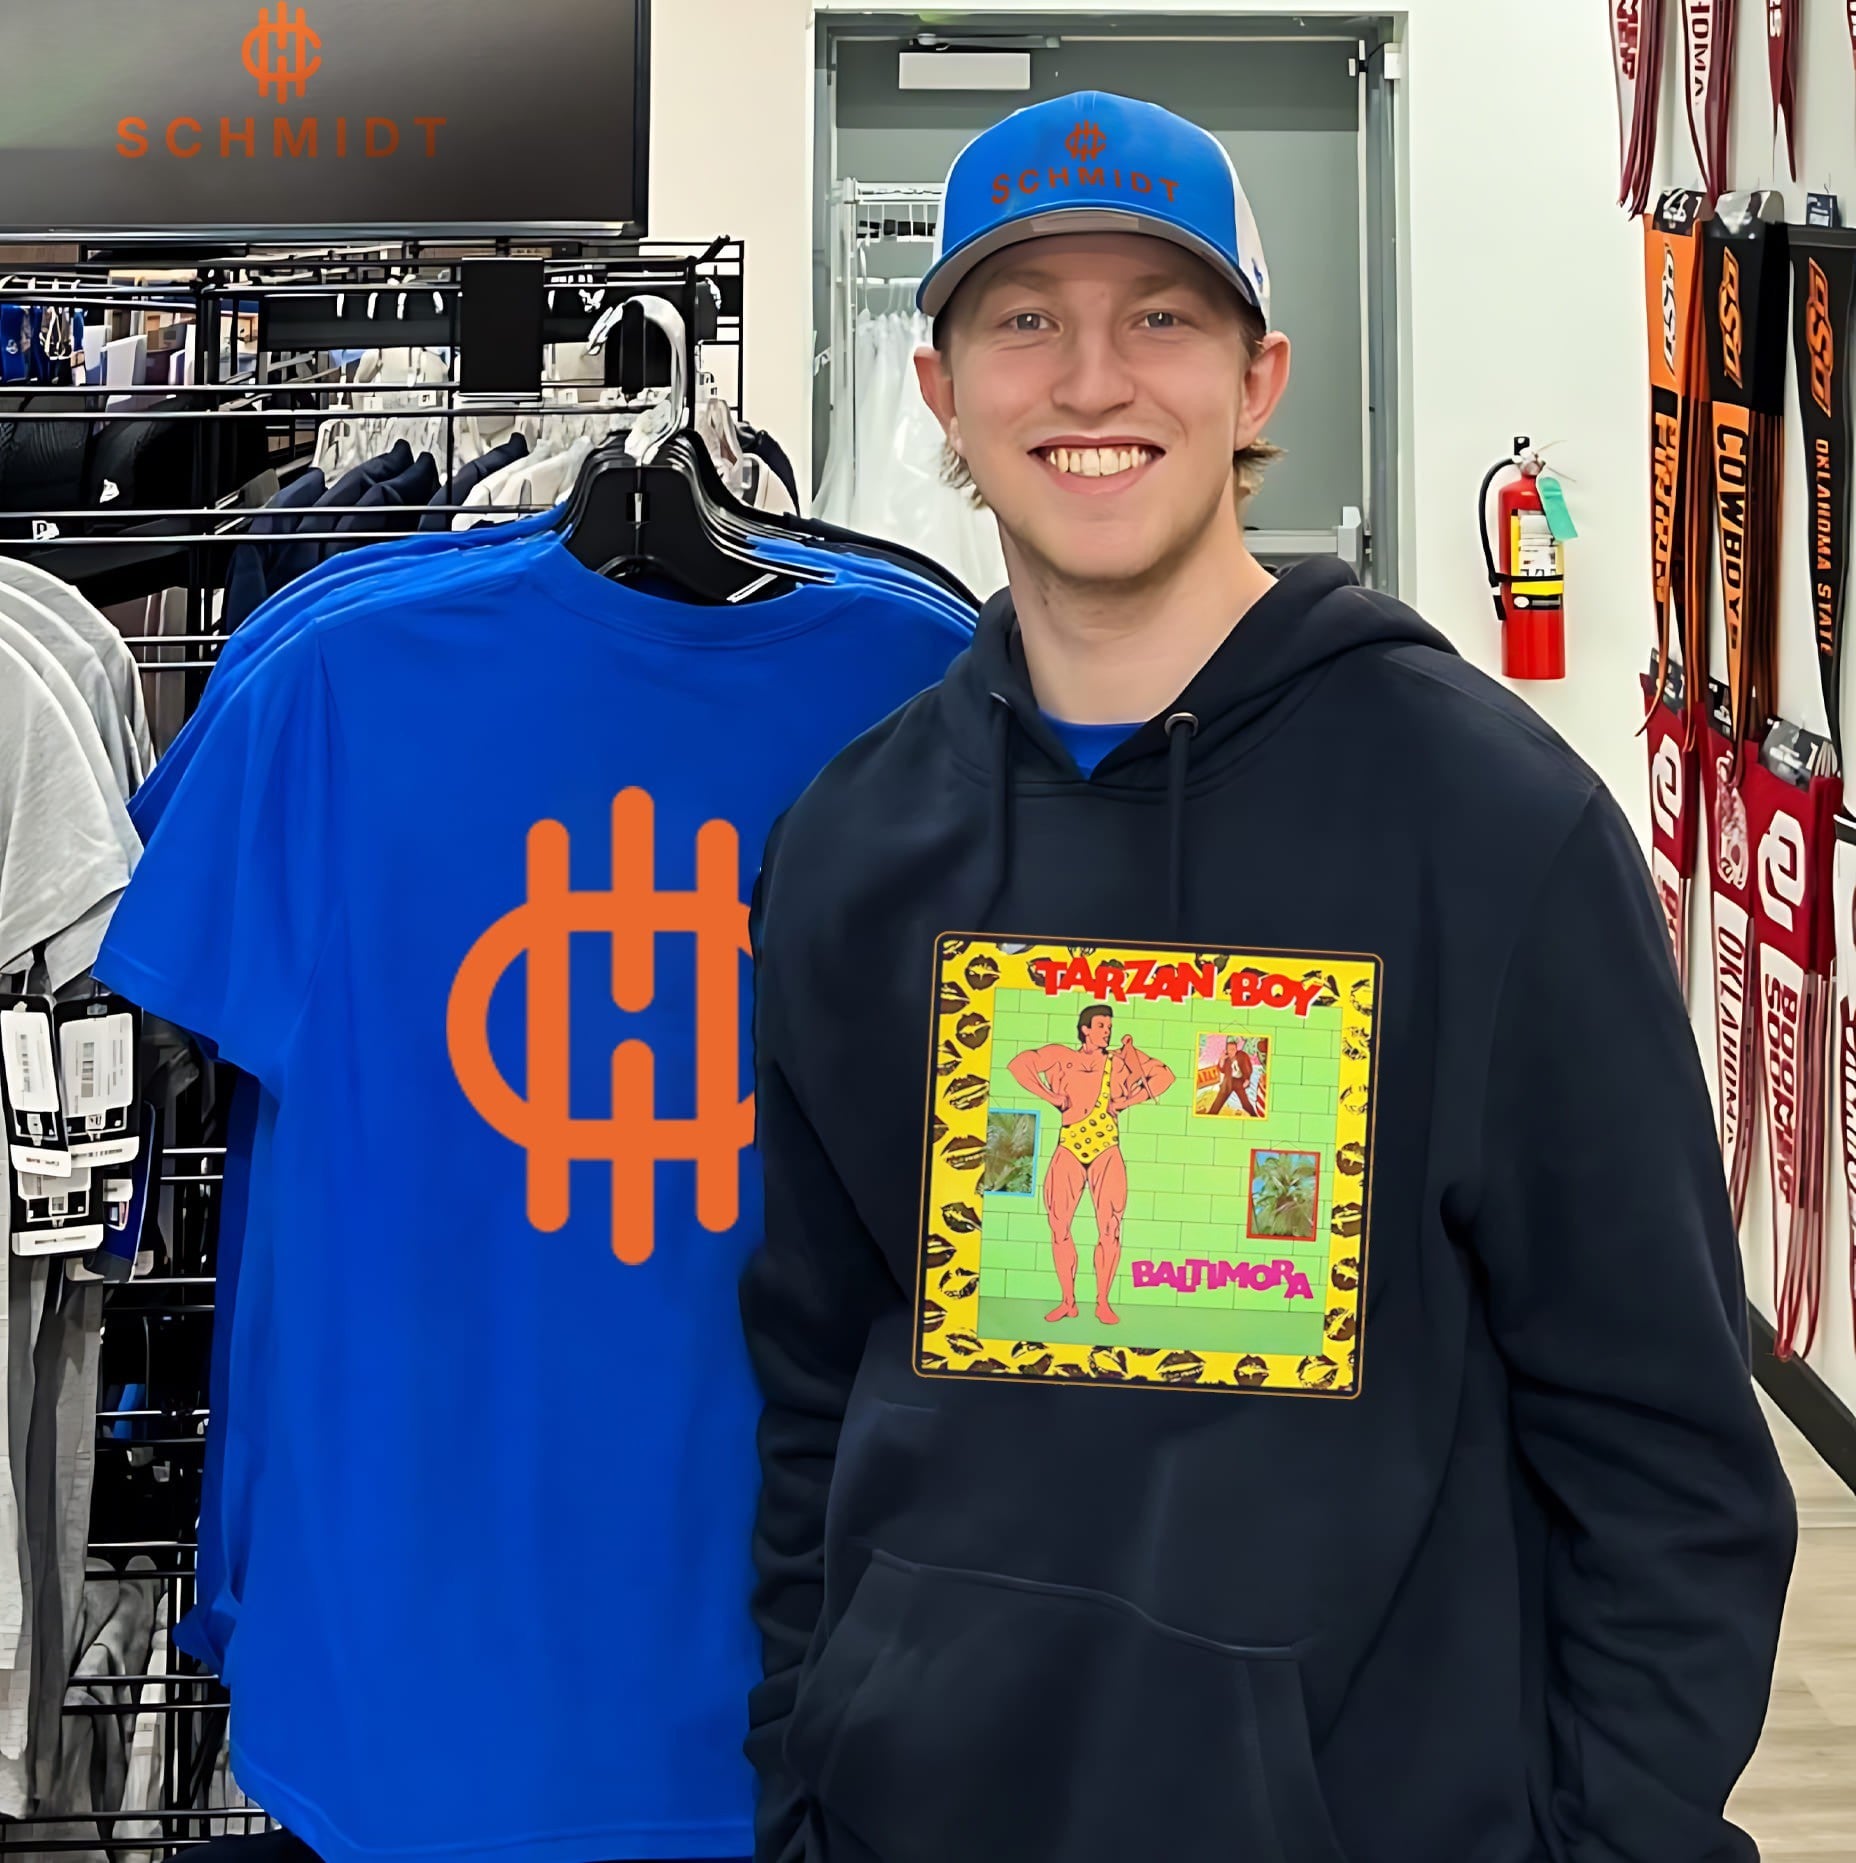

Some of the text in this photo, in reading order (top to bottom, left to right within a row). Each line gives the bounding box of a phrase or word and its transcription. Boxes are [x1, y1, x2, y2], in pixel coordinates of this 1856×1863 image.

[116, 117, 447, 158] SCHMIDT
[991, 166, 1180, 205] SCHMIDT
[1815, 438, 1834, 657] OKLAHOMA STATE
[1034, 956, 1324, 1017] TARZAN BOY
[1132, 1258, 1314, 1300] BALTIMORA
